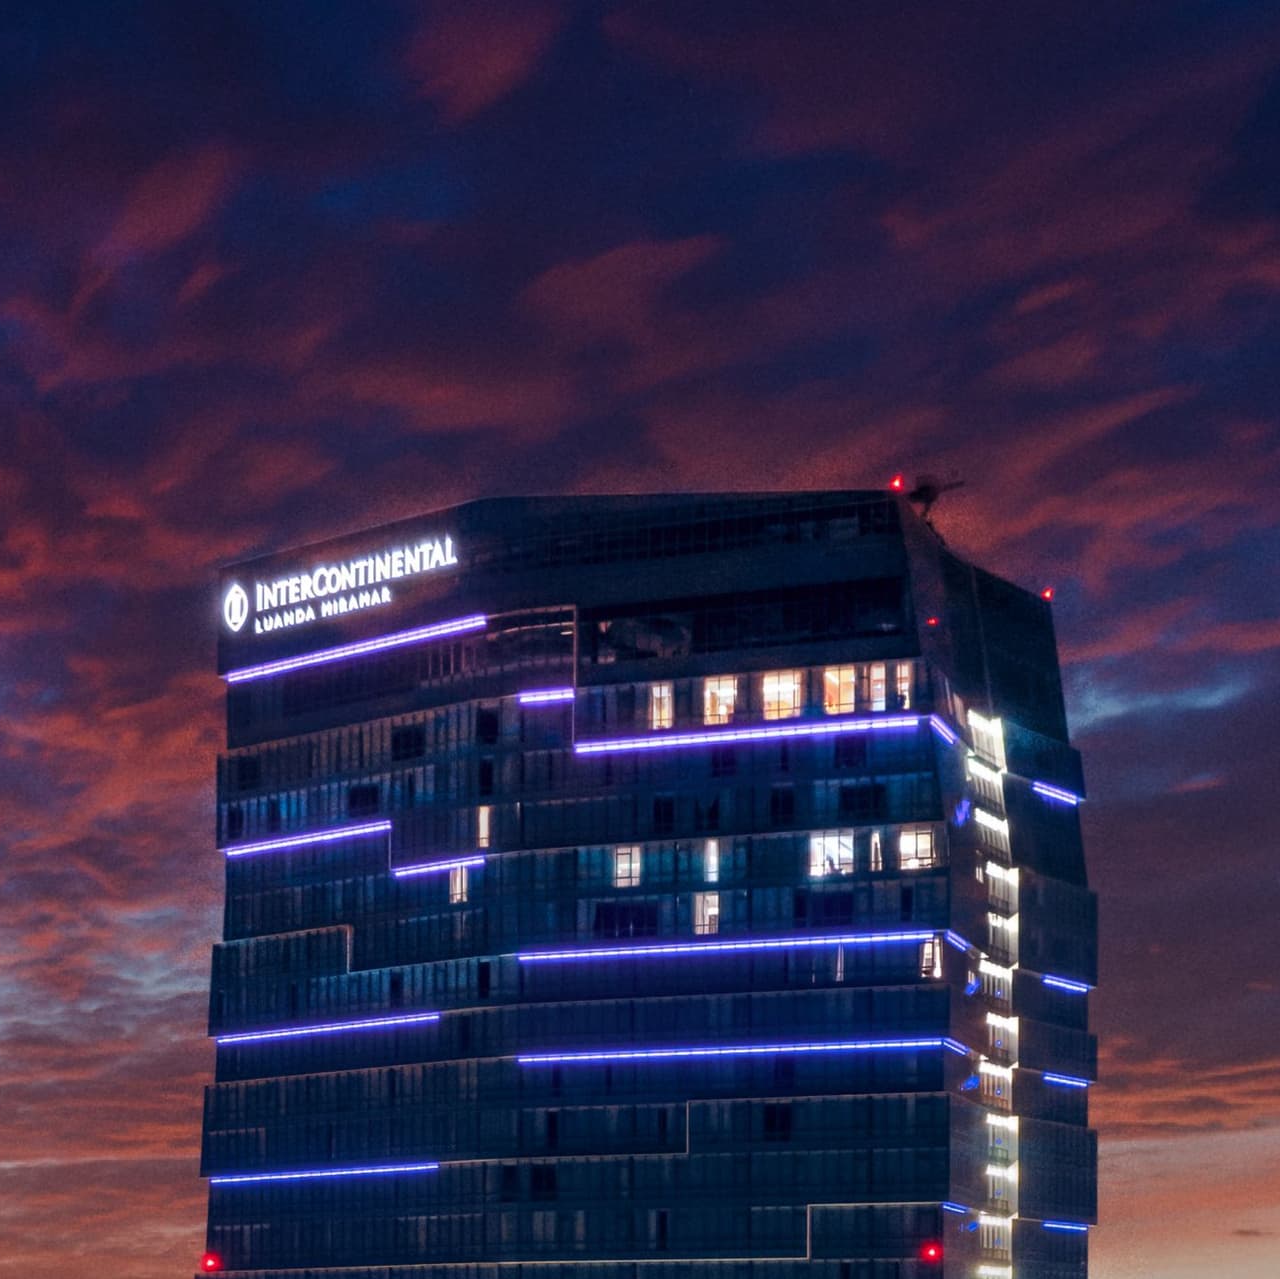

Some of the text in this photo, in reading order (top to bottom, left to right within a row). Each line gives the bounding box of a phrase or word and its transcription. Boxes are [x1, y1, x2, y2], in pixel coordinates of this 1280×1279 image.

[255, 535, 458, 612] INTERCONTINENTAL
[255, 587, 392, 634] LUANDA MIRAMAR
